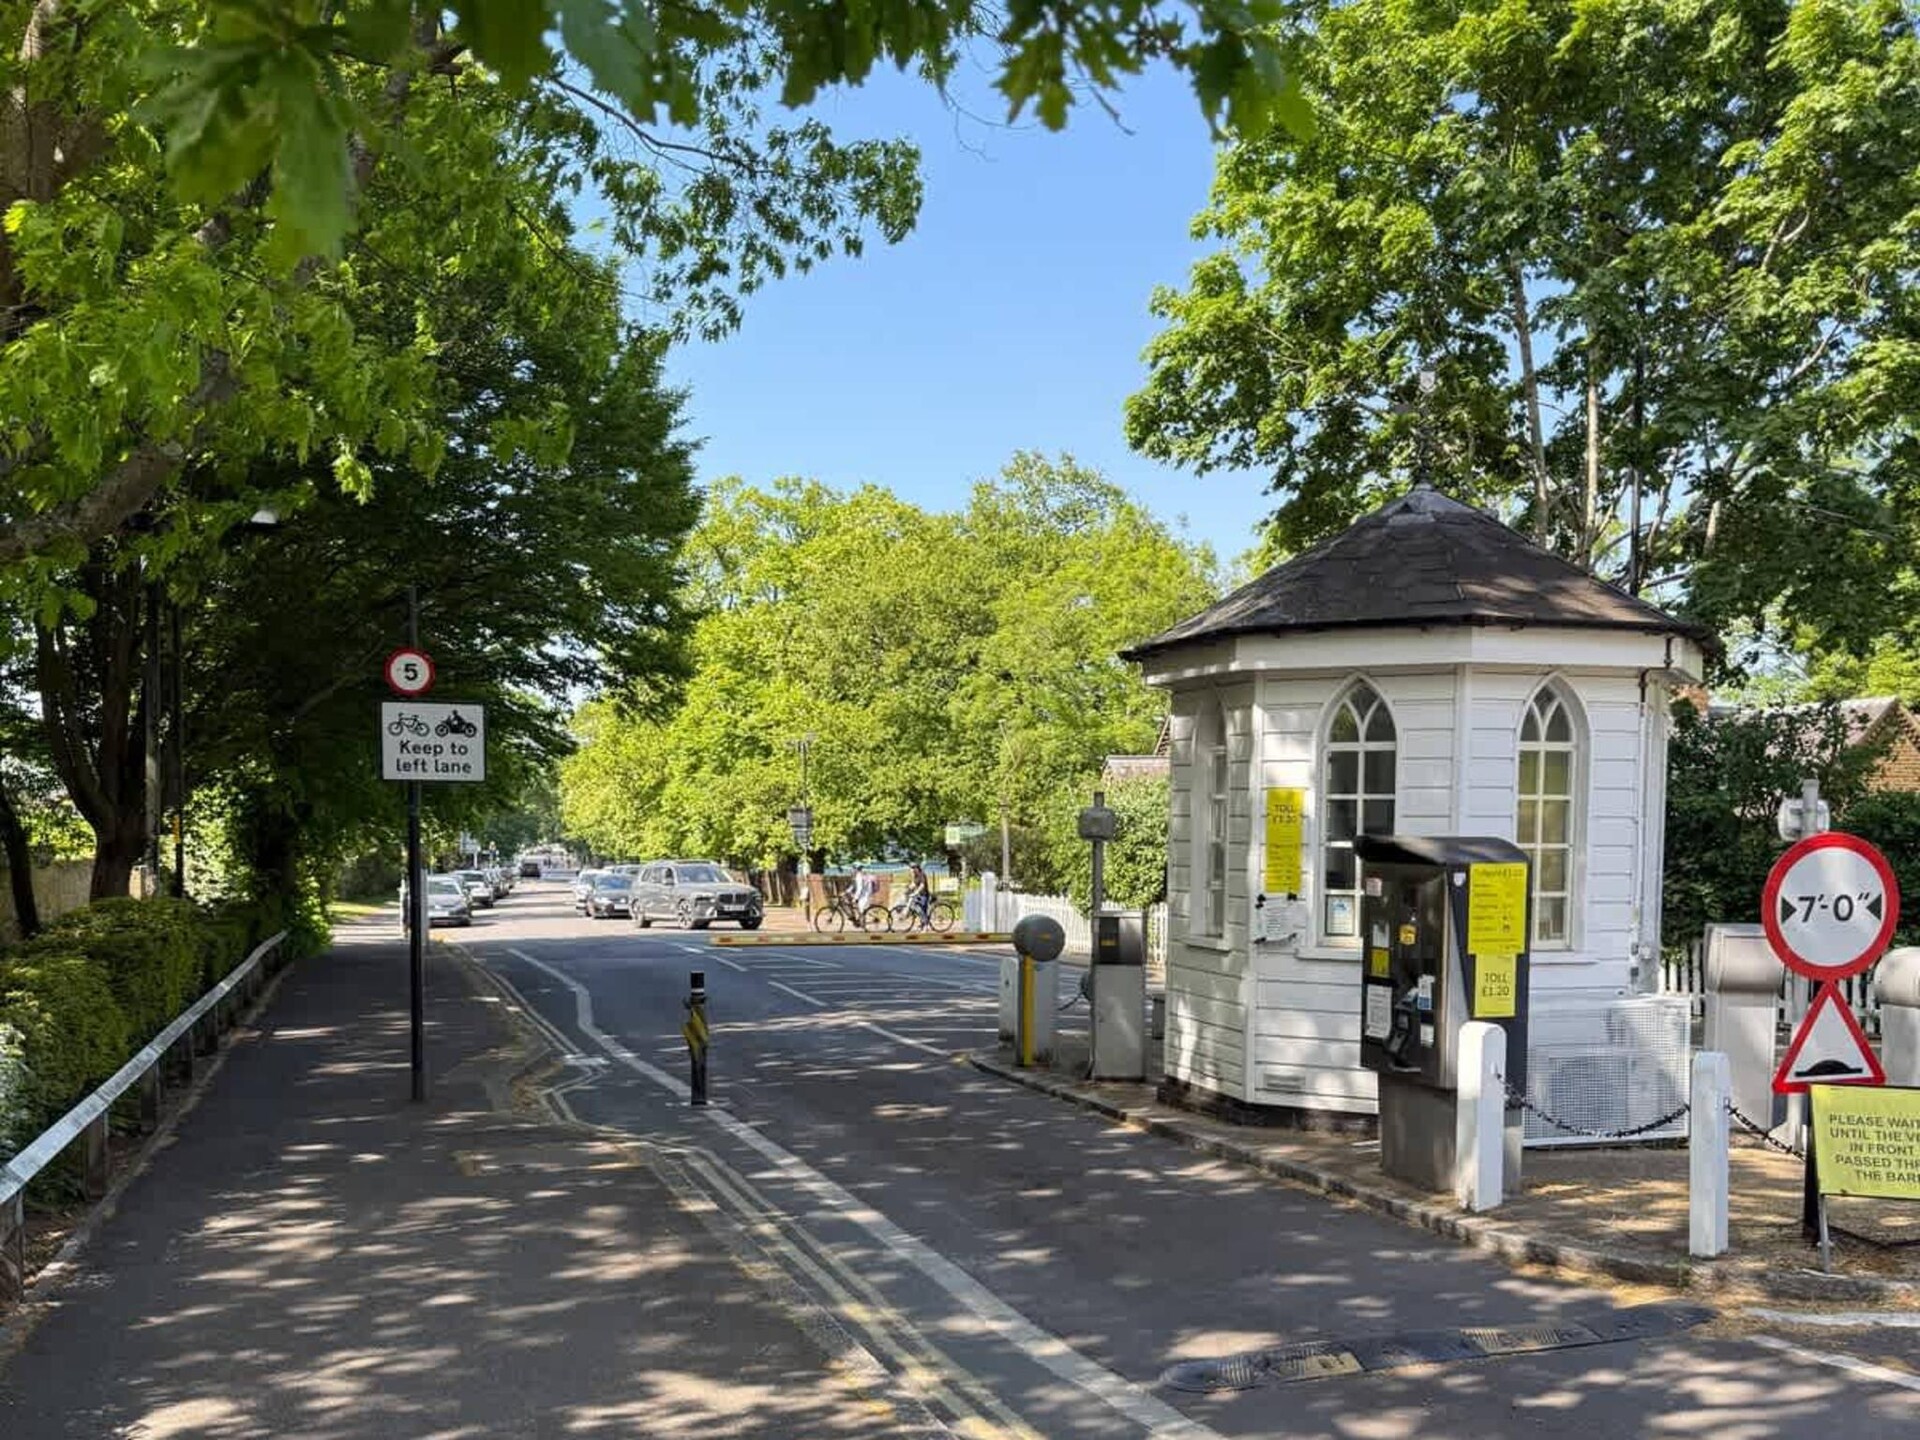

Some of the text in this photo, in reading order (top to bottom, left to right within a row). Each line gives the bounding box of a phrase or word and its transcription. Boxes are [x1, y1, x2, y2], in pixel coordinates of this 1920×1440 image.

[404, 663, 418, 681] 5
[400, 740, 468, 757] Keep to
[396, 759, 472, 773] left lane
[1484, 972, 1508, 983] TOLL
[1829, 1114, 1884, 1127] PLEASE
[1830, 1127, 1871, 1140] UNTIL
[1874, 1130, 1904, 1142] THE
[1850, 1143, 1914, 1156] IN FRONT
[1835, 1154, 1892, 1168] PASSED
[1855, 1169, 1920, 1183] THE BAR
